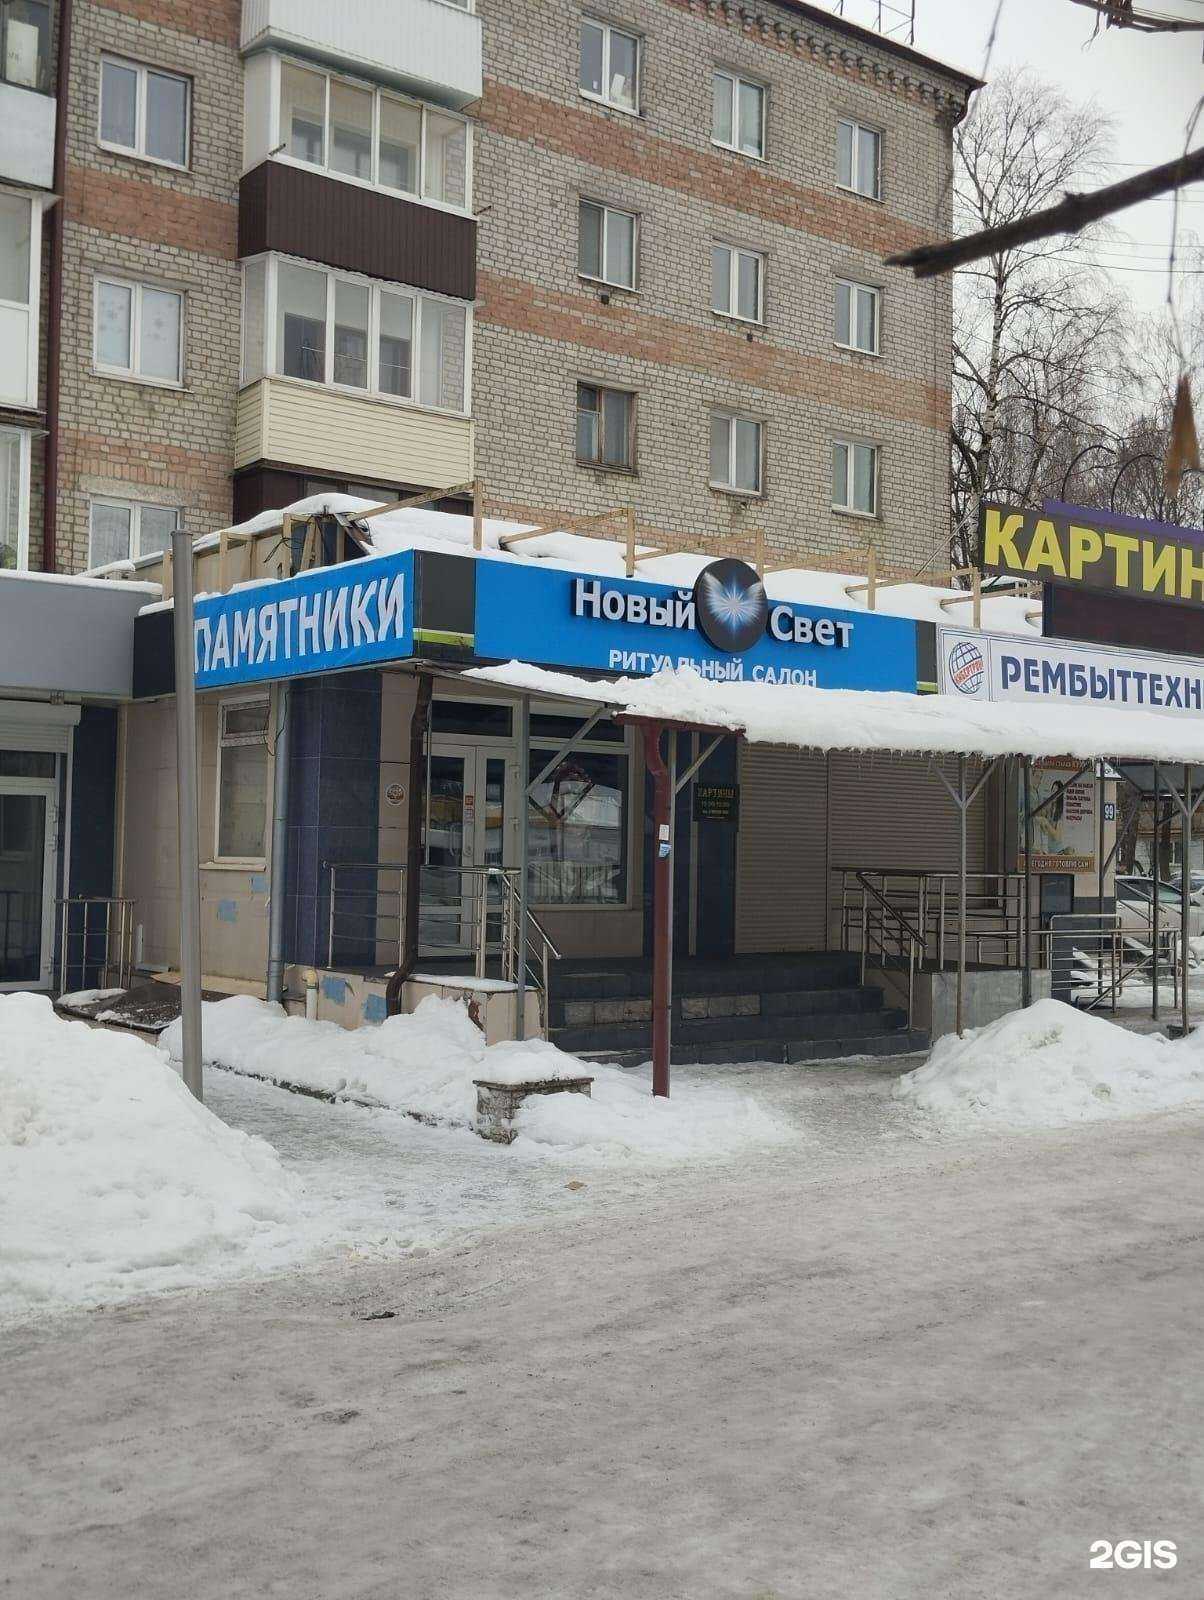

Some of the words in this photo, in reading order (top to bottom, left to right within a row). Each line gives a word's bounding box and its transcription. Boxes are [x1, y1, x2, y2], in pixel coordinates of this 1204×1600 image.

[194, 573, 405, 673] ПАМЯТНИКИ
[573, 578, 696, 630] Новый
[769, 605, 854, 648] Свет
[752, 665, 817, 688] САЛОН
[1001, 655, 1204, 710] РЕМБЫТТЕХН
